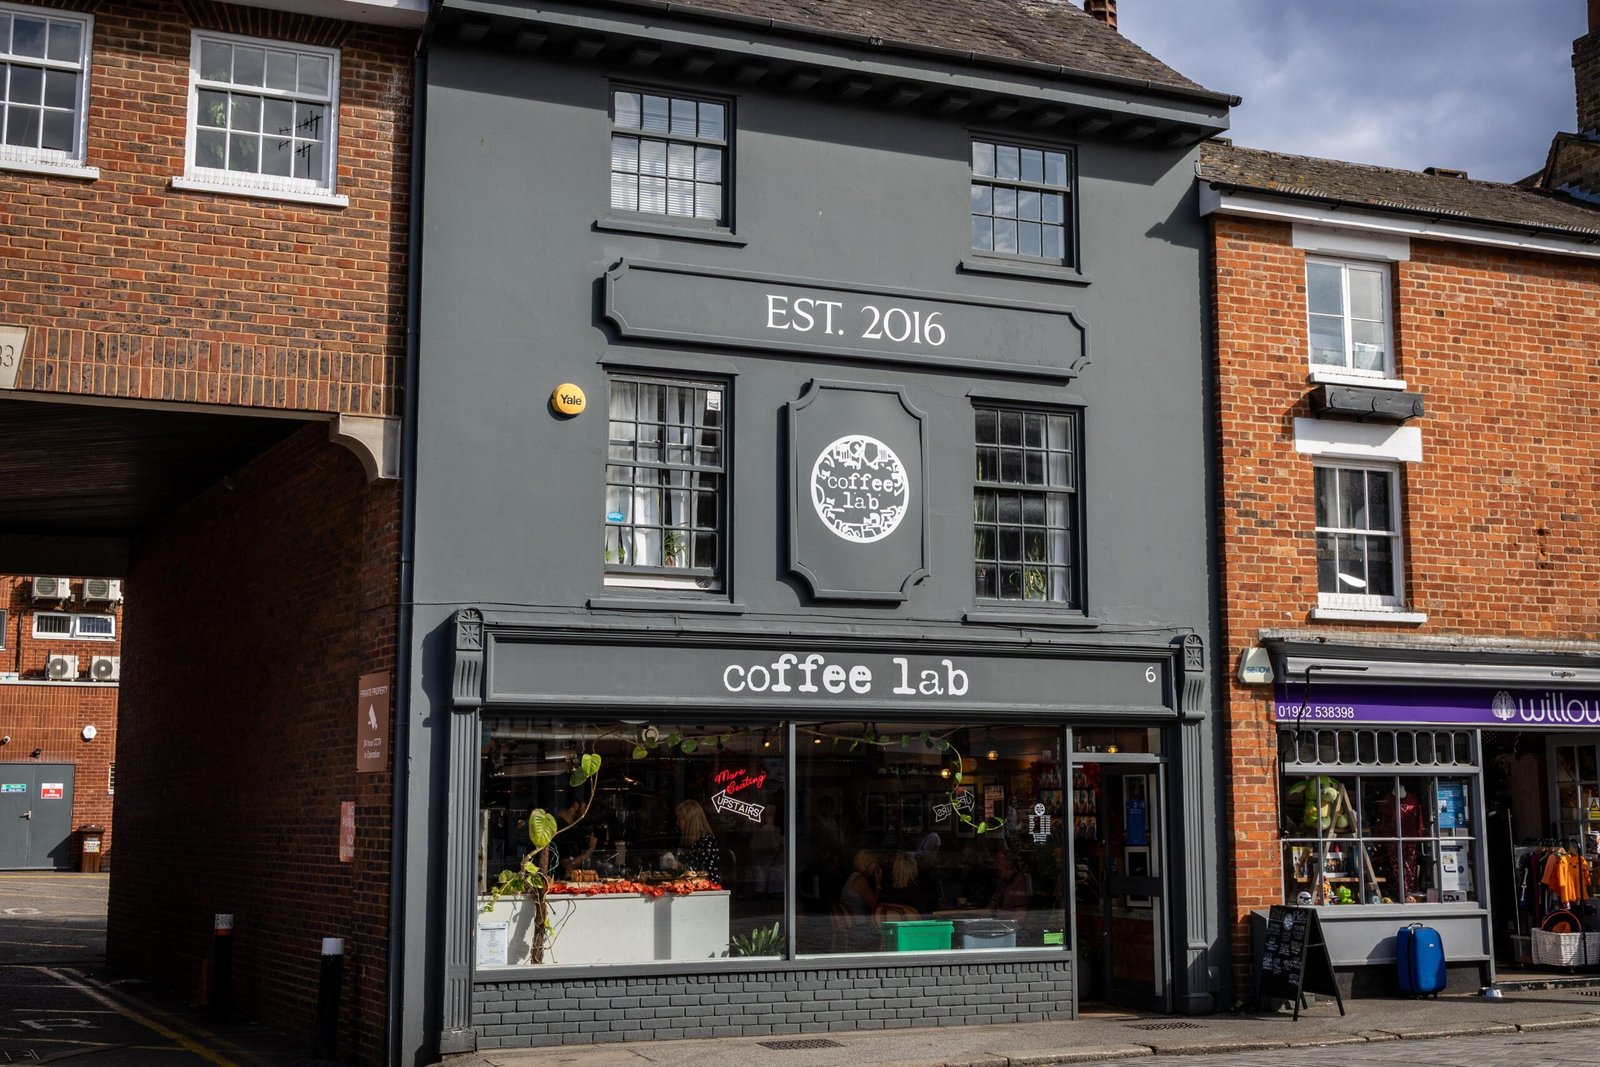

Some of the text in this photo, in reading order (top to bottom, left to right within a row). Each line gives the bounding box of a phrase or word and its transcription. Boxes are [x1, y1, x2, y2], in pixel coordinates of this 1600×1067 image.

[766, 294, 946, 346] EST. 2016
[0, 344, 14, 367] 3
[560, 394, 582, 406] Yale
[827, 472, 894, 492] coffee
[843, 491, 880, 510] lab
[723, 653, 969, 696] coffee lab
[1145, 666, 1156, 683] 6
[1246, 666, 1271, 674] SECOM
[1315, 706, 1355, 719] 538398
[714, 769, 746, 784] More
[726, 774, 767, 794] Seating
[717, 796, 760, 817] UPSTAIRS
